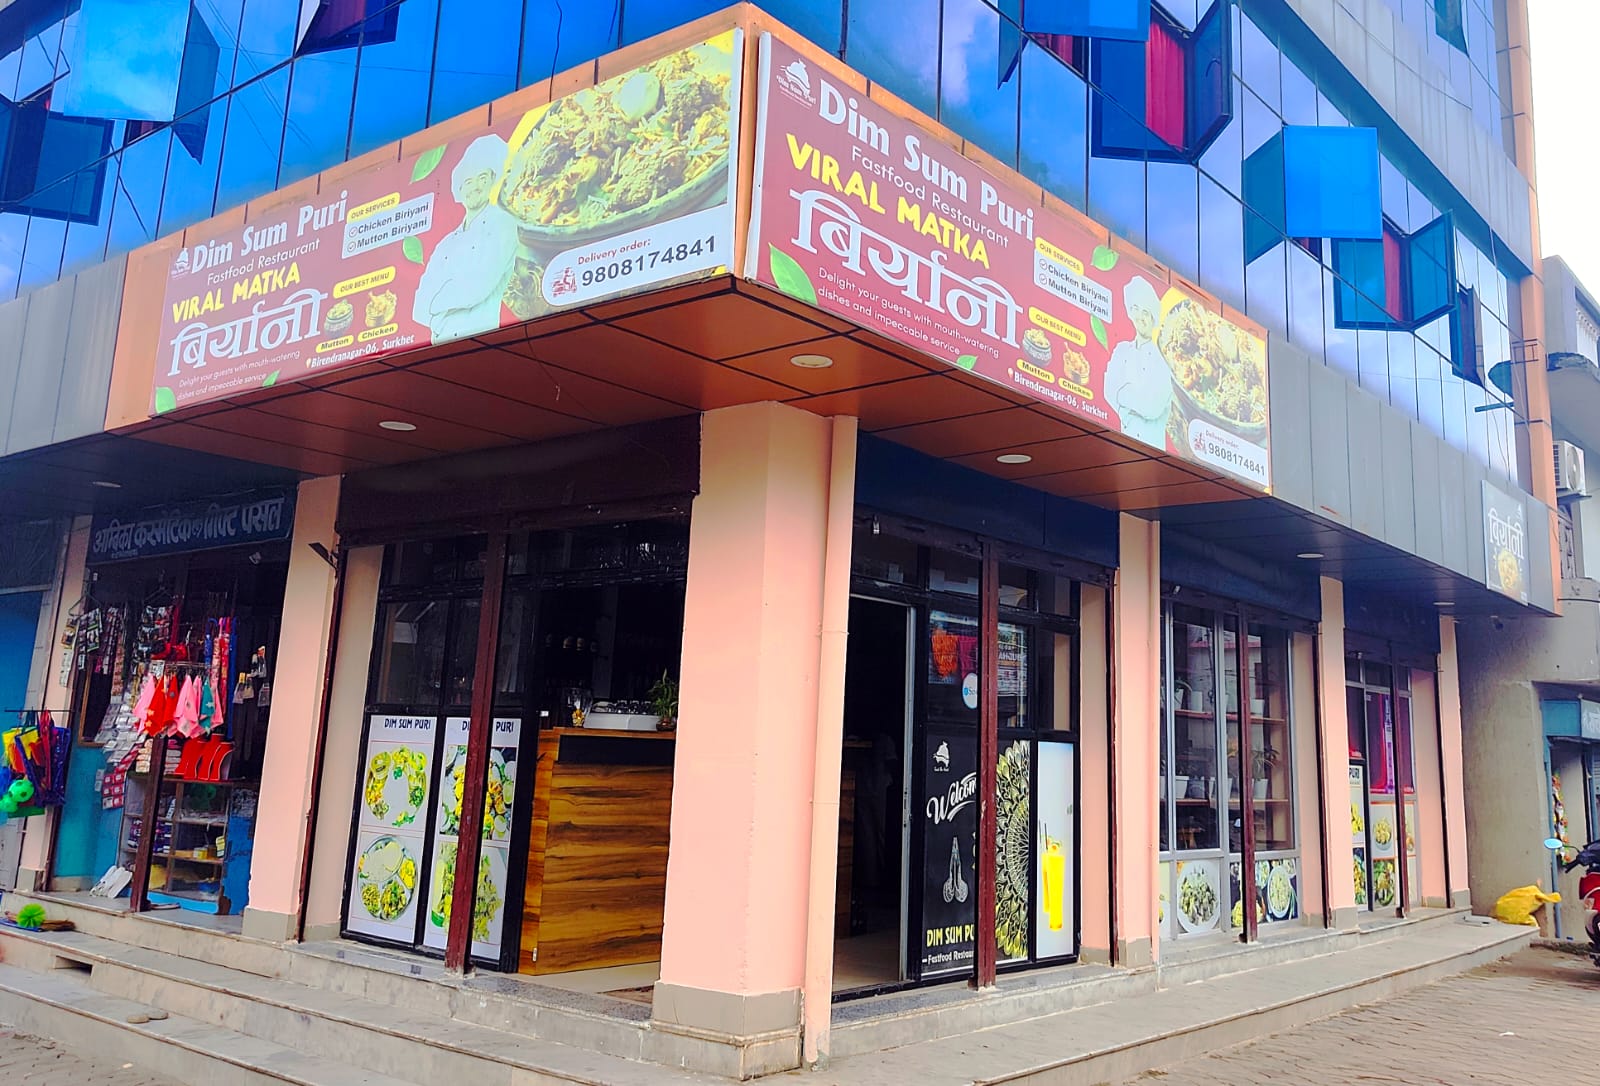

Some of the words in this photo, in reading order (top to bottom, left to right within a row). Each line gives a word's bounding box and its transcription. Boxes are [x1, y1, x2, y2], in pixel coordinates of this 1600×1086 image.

[819, 79, 890, 156] Dim
[904, 135, 967, 202] Sum
[980, 180, 1034, 241] Puri
[351, 211, 363, 219] OUR
[365, 198, 396, 214] SERVICES
[786, 132, 886, 214] VIRAL
[897, 196, 990, 269] MATKA
[852, 145, 926, 200] Fastfood
[933, 192, 1009, 248] Restaurant
[192, 239, 233, 273] Dim
[241, 221, 287, 257] Sum
[297, 190, 348, 237] Puri
[357, 232, 388, 248] Mutton
[392, 217, 426, 236] Biriyani
[359, 217, 391, 233] Chicken
[395, 202, 428, 221] Biriyani
[207, 258, 254, 286] Fastfood
[258, 238, 320, 269] Restaurant
[578, 248, 617, 265] Delivery
[620, 239, 651, 253] order:
[582, 236, 715, 286] 9808174841
[1040, 243, 1052, 254] OUR
[1053, 250, 1080, 270] SERVICES
[340, 284, 353, 292] OUR
[355, 279, 369, 288] BEST
[371, 272, 390, 283] MENU
[790, 189, 1023, 349] बिर्यानी
[1048, 265, 1079, 287] Chicken
[1081, 282, 1108, 303] Biriyani
[173, 288, 224, 323] VIRAL
[232, 262, 300, 304] MATKA
[1049, 278, 1076, 300] Mutton
[1080, 295, 1108, 316] Biriyani
[818, 287, 850, 307] dishes
[853, 303, 871, 316] and
[874, 311, 928, 342] impeccable
[931, 337, 960, 354] service
[819, 268, 855, 291] Delight
[858, 287, 879, 303] your
[882, 298, 912, 318] guests
[914, 313, 932, 326] with
[934, 322, 999, 358] mouth-watering
[1036, 314, 1049, 326] OUR
[1050, 320, 1063, 333] BEST
[168, 288, 328, 376] बिर्यानी
[321, 338, 348, 350] Mutton
[362, 326, 394, 339] Chicken
[312, 345, 378, 368] Birendranagar-06,
[383, 334, 414, 350] Surkhet
[1022, 362, 1050, 380] Mutton
[1014, 372, 1079, 409] Birendranagar-06,
[1082, 401, 1108, 420] Surkhet
[1063, 380, 1090, 397] Chicken
[1206, 430, 1224, 444] Delivery
[1209, 443, 1265, 476] 9808174841
[384, 718, 397, 728] DIM
[399, 719, 412, 729] SUM
[414, 719, 431, 730] PURI
[496, 721, 514, 733] PURI
[927, 928, 943, 947] DIM
[945, 925, 962, 944] SUM
